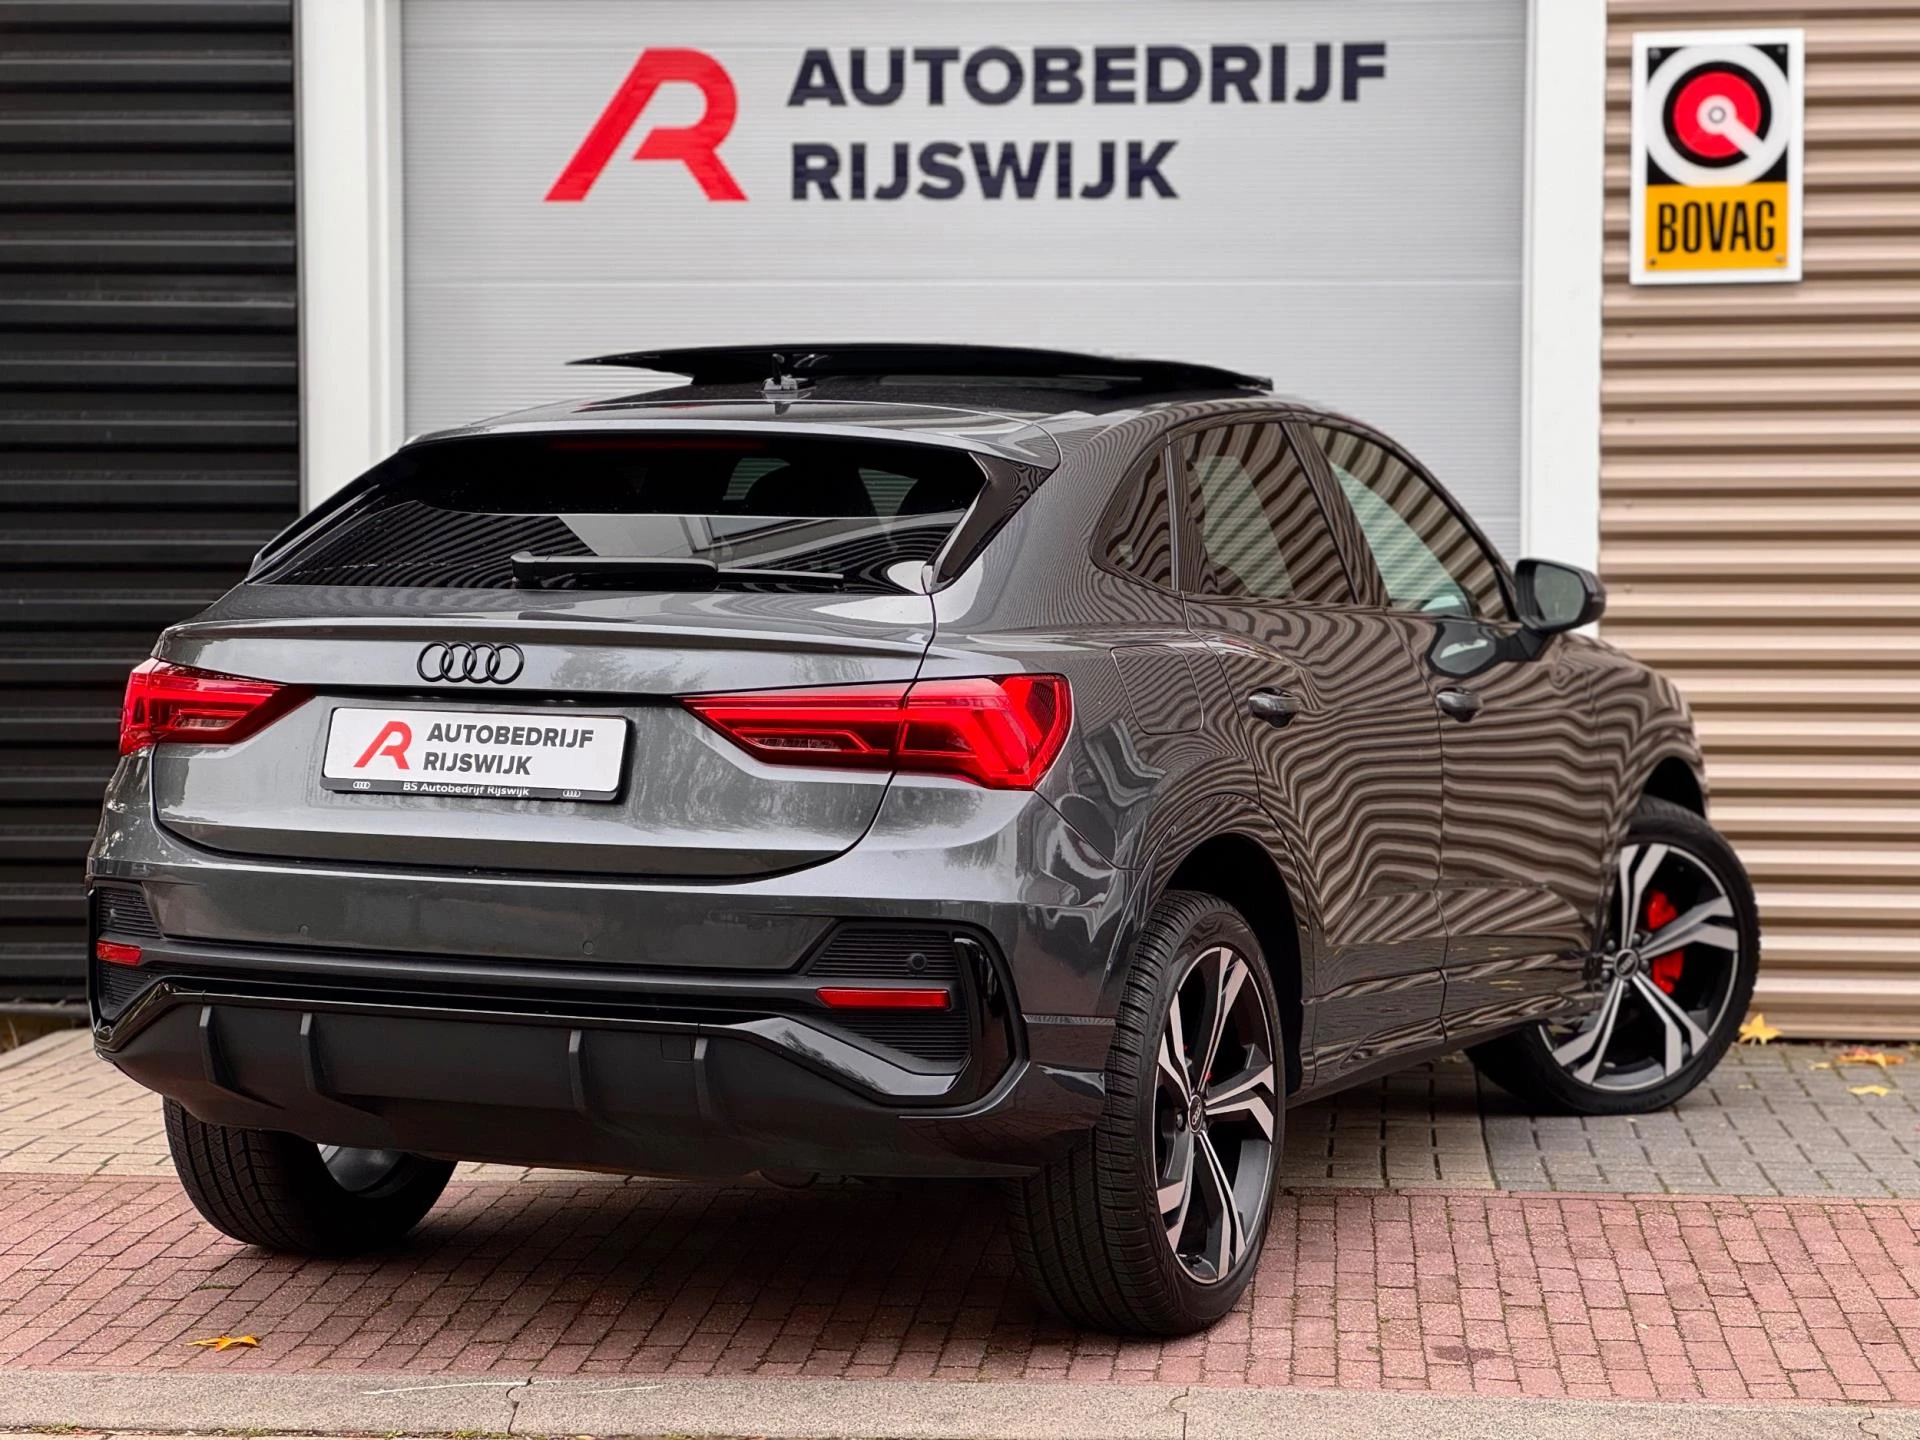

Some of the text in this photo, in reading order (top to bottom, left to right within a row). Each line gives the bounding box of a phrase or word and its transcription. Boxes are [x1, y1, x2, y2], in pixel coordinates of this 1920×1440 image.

[788, 42, 1387, 107] AUTOBEDRIJF
[793, 140, 1178, 201] RIJSWIJK
[1657, 200, 1776, 254] BOVAG
[427, 723, 595, 748] AUTOBEDRIJF
[423, 752, 533, 775] RIJSWIJK
[402, 781, 530, 797] BS Autobedrijf Rijswijk
